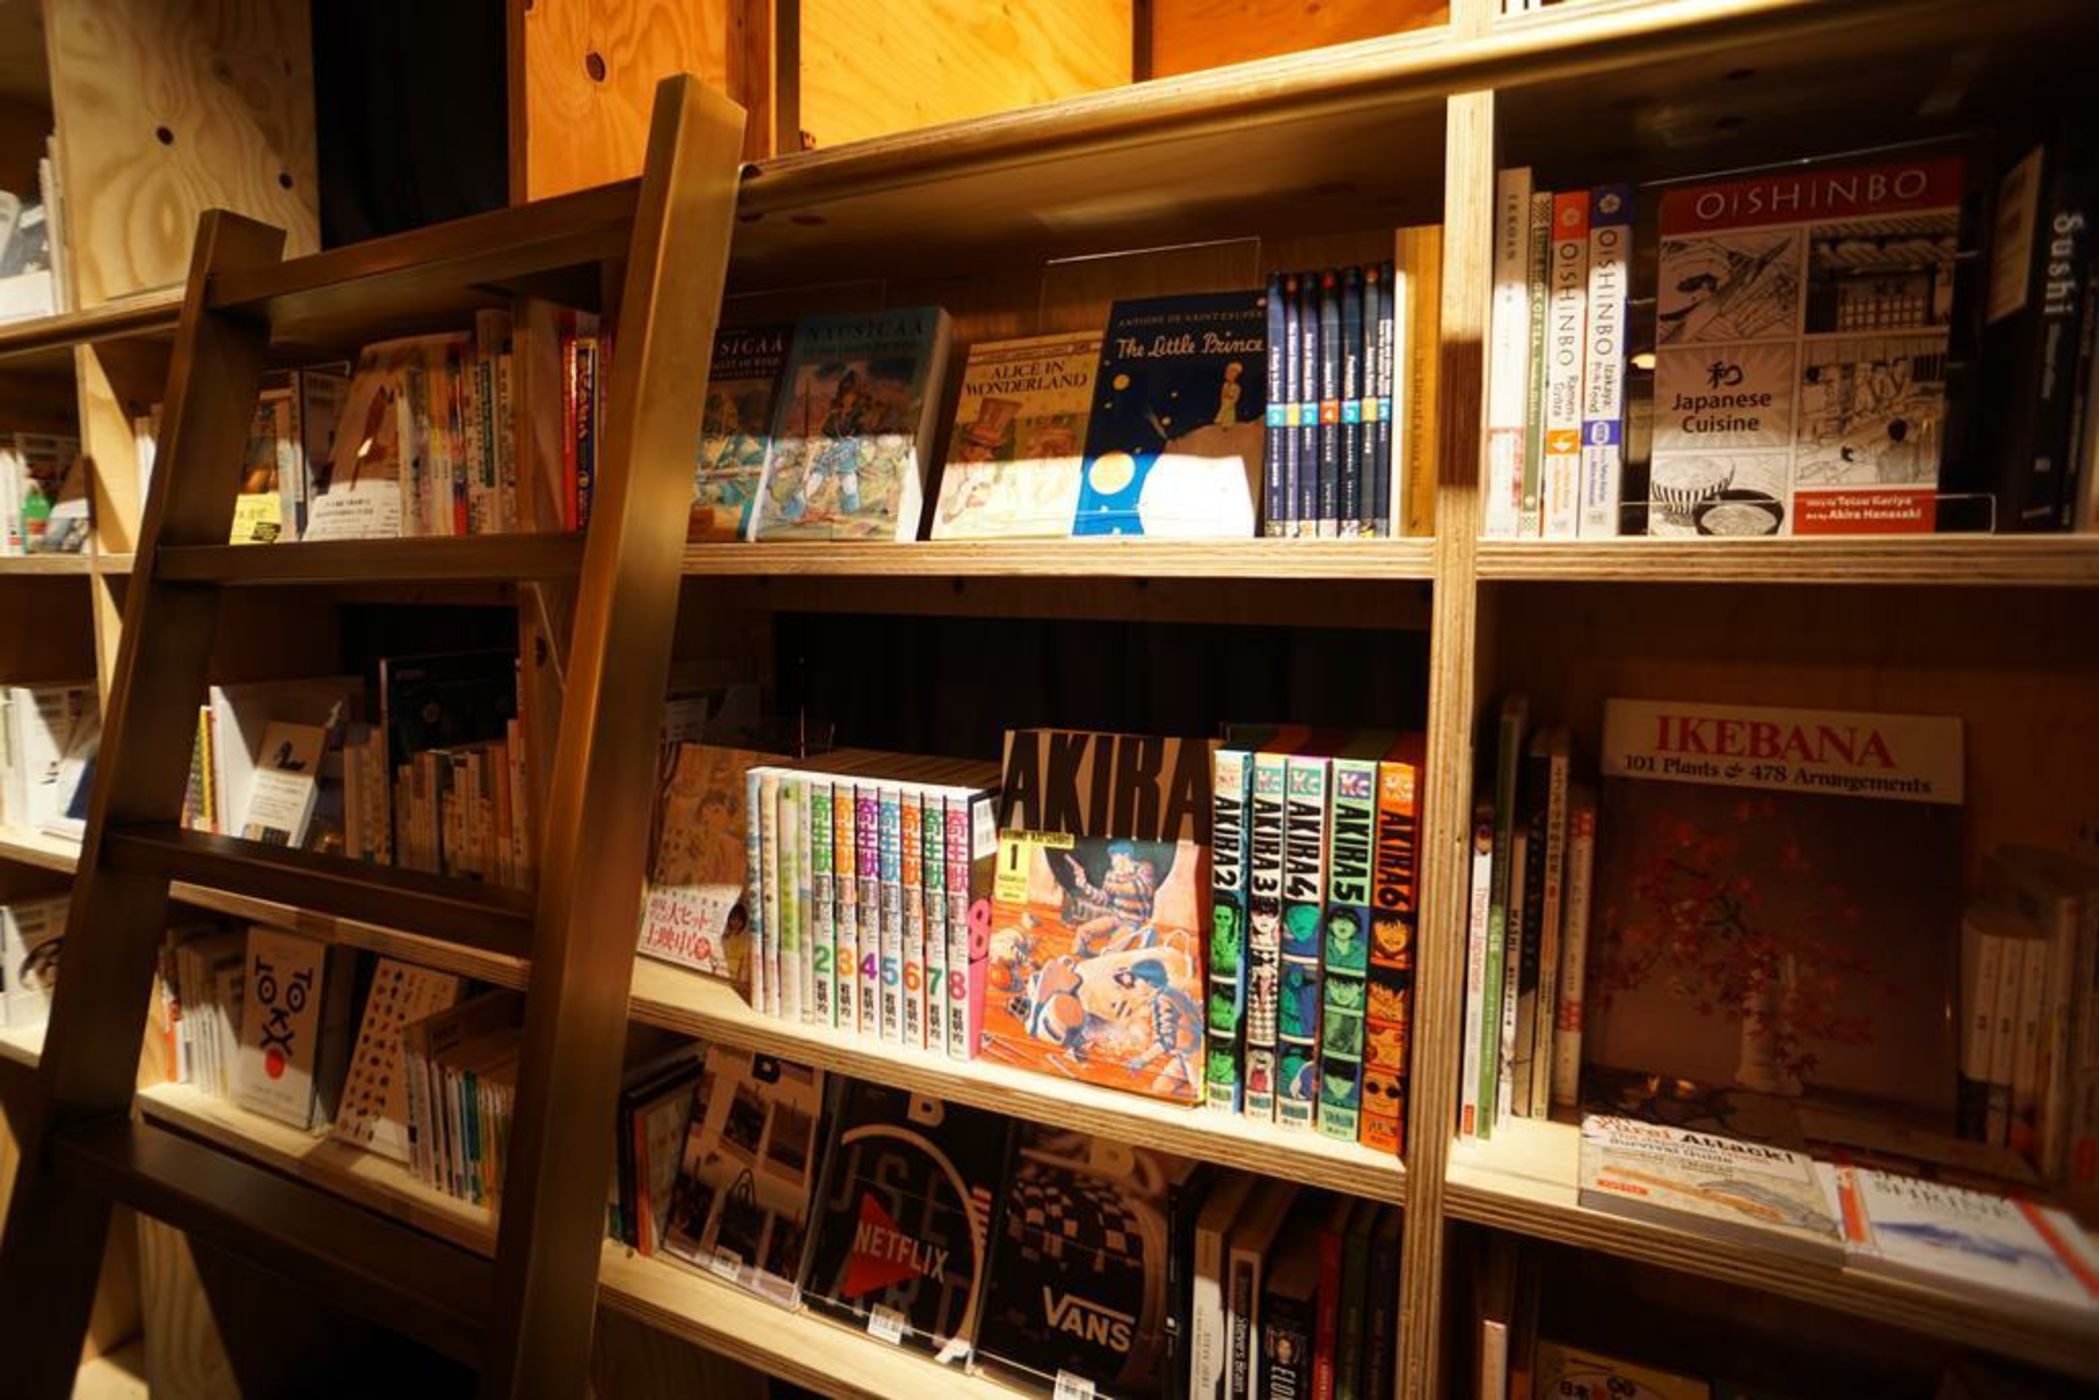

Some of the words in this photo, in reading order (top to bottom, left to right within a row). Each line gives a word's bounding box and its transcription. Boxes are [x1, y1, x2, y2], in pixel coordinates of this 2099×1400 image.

[1695, 169, 1928, 221] OISHINBO
[2043, 208, 2084, 316] Sushi
[1556, 242, 1580, 368] OISHINBO
[1594, 229, 1617, 357] OISHINBO
[1115, 337, 1145, 360] The
[1147, 332, 1196, 358] Little
[1201, 331, 1265, 355] Prince
[966, 373, 1088, 396] WONDERLAND
[991, 362, 1040, 380] ALICE
[1044, 360, 1066, 375] IN
[1706, 361, 1744, 389] 和
[1672, 392, 1772, 414] Japanese
[1681, 415, 1760, 434] Cuisine
[1828, 508, 1861, 520] Akira
[1655, 715, 1897, 769] IKEBANA
[999, 732, 1213, 845] AKIRA
[1624, 754, 1656, 772] 101
[1663, 757, 1721, 779] Plants
[1724, 763, 1746, 779] &
[1749, 764, 1788, 783] 478
[1793, 766, 1932, 794] Arrangements
[1214, 795, 1242, 866] AKIRA
[1253, 798, 1282, 870] AKIRA
[1286, 800, 1322, 875] AKIRA
[1332, 803, 1371, 878] AKIRA
[1377, 808, 1414, 886] AKIRA
[1473, 886, 1489, 929] Things
[967, 897, 992, 961] 8
[814, 944, 831, 974] 2
[837, 948, 854, 976] 3
[860, 952, 878, 980] 4
[881, 957, 899, 986] 5
[904, 960, 921, 992] 6
[1470, 933, 1486, 994] Japanese
[926, 966, 943, 996] 7
[949, 970, 966, 1001] 8
[1680, 1133, 1795, 1165] Attack!
[1683, 1147, 1733, 1164] Guide
[855, 1223, 950, 1284] NETFLIX
[1041, 1284, 1137, 1354] VANS
[1232, 1315, 1249, 1360] Steve's
[1232, 1360, 1249, 1394] Brain
